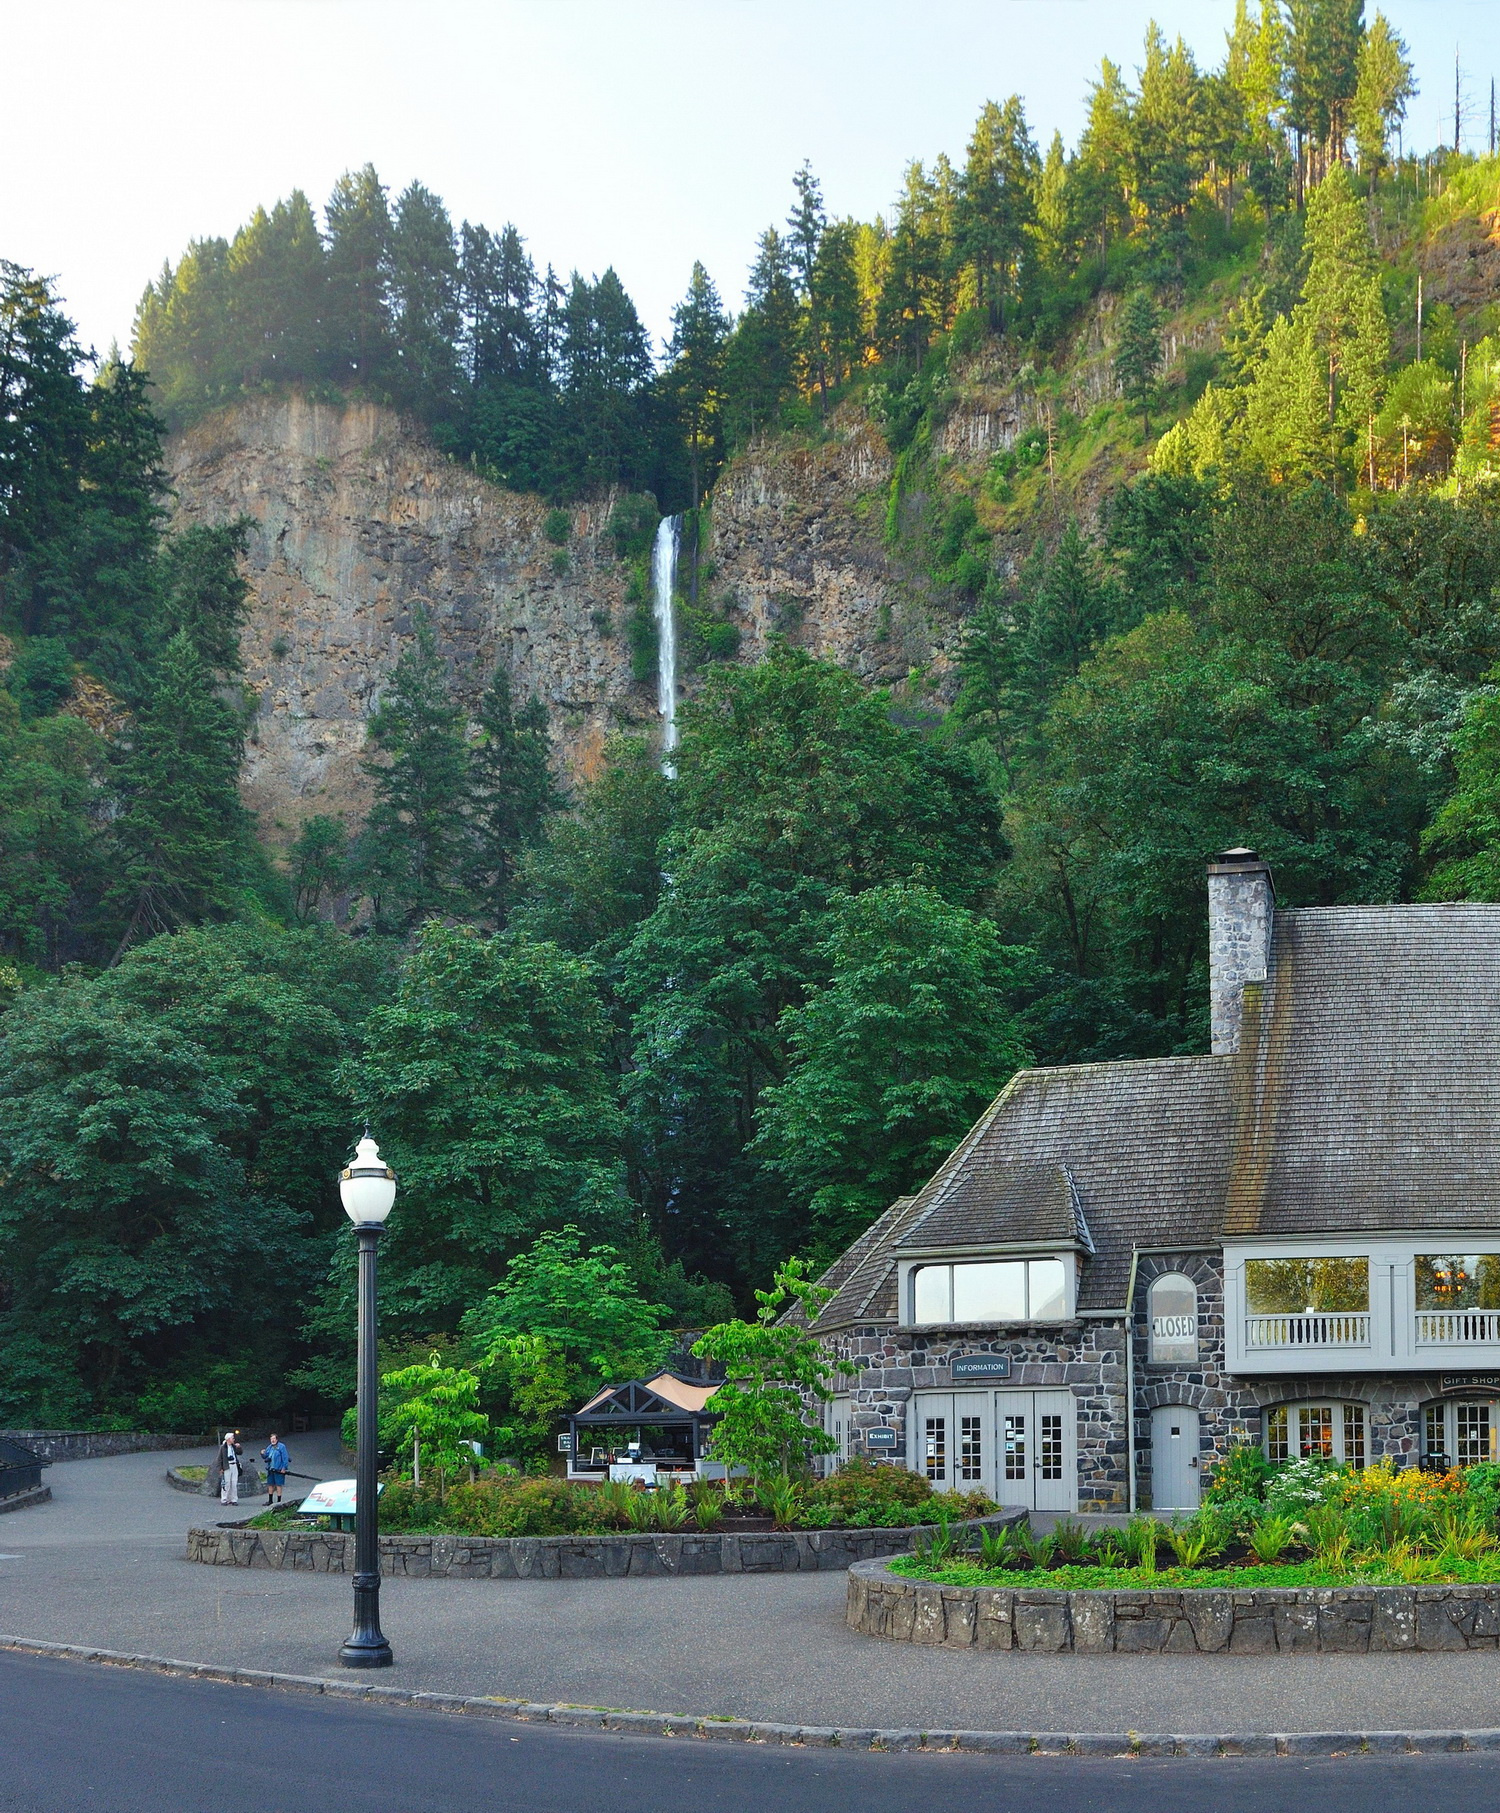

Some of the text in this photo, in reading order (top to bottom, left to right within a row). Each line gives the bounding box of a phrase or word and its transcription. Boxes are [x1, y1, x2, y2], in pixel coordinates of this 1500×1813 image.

[1153, 1316, 1195, 1338] CLOSED
[956, 1362, 1004, 1372] INFORMATION
[1443, 1376, 1500, 1384] GIFT SHOP
